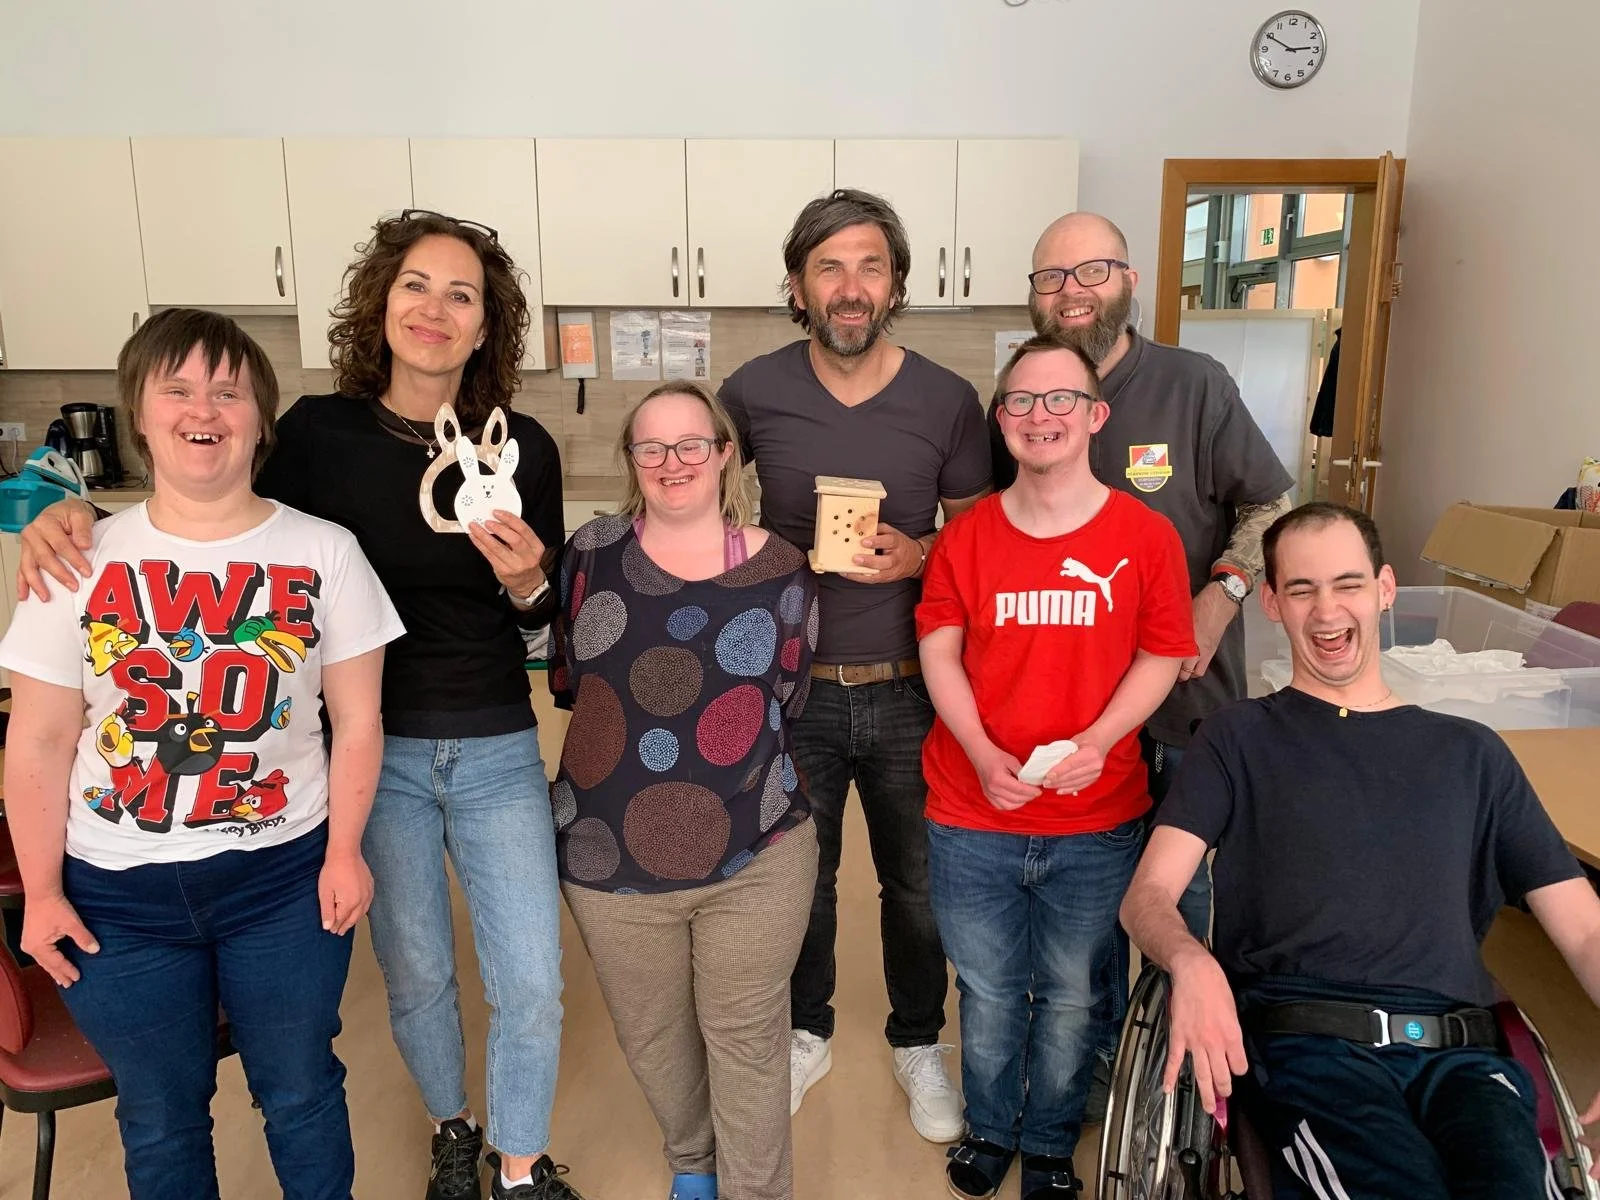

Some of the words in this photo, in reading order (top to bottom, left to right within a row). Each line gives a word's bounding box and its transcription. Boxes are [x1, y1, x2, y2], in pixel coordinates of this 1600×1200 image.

[1277, 22, 1282, 30] 11
[1289, 18, 1298, 26] 12
[1312, 46, 1319, 54] 3
[86, 559, 322, 647] AWE
[995, 590, 1097, 626] PUMA
[111, 648, 279, 742] SO
[98, 752, 259, 832] ME
